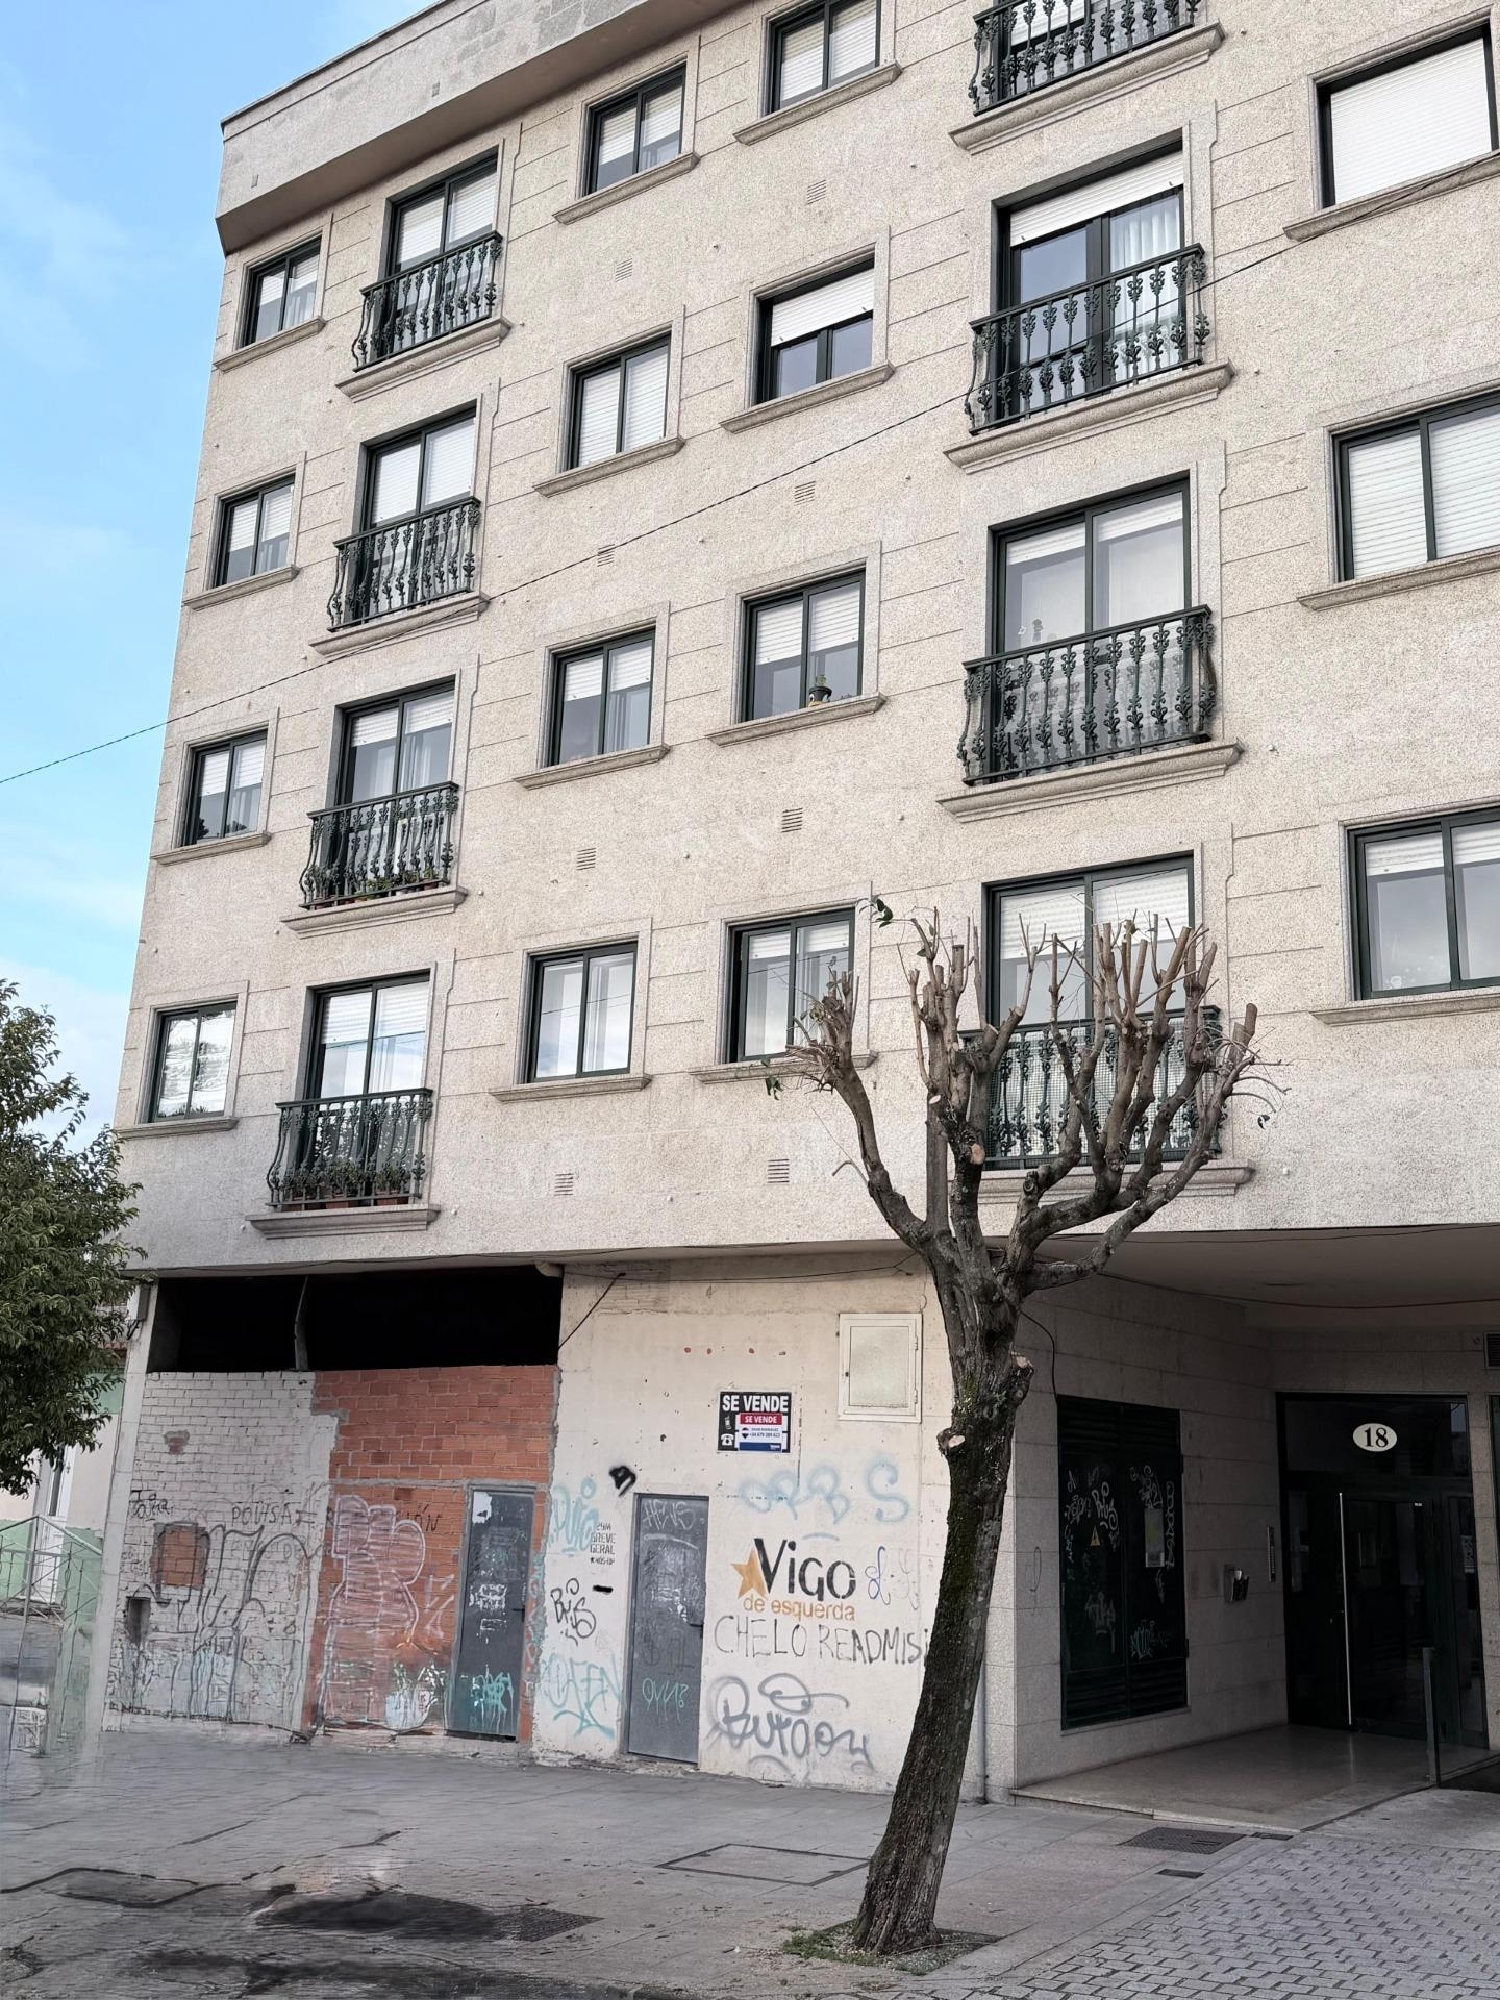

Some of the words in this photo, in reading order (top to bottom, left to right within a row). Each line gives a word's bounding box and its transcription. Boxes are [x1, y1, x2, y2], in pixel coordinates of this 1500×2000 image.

[722, 1395, 740, 1411] SE
[743, 1395, 789, 1412] VENDE
[745, 1416, 752, 1424] SE
[754, 1416, 777, 1424] VENDE
[1364, 1427, 1389, 1448] 18
[743, 1594, 766, 1613] de
[771, 1599, 856, 1621] esquerda
[714, 1615, 808, 1659] CHELO
